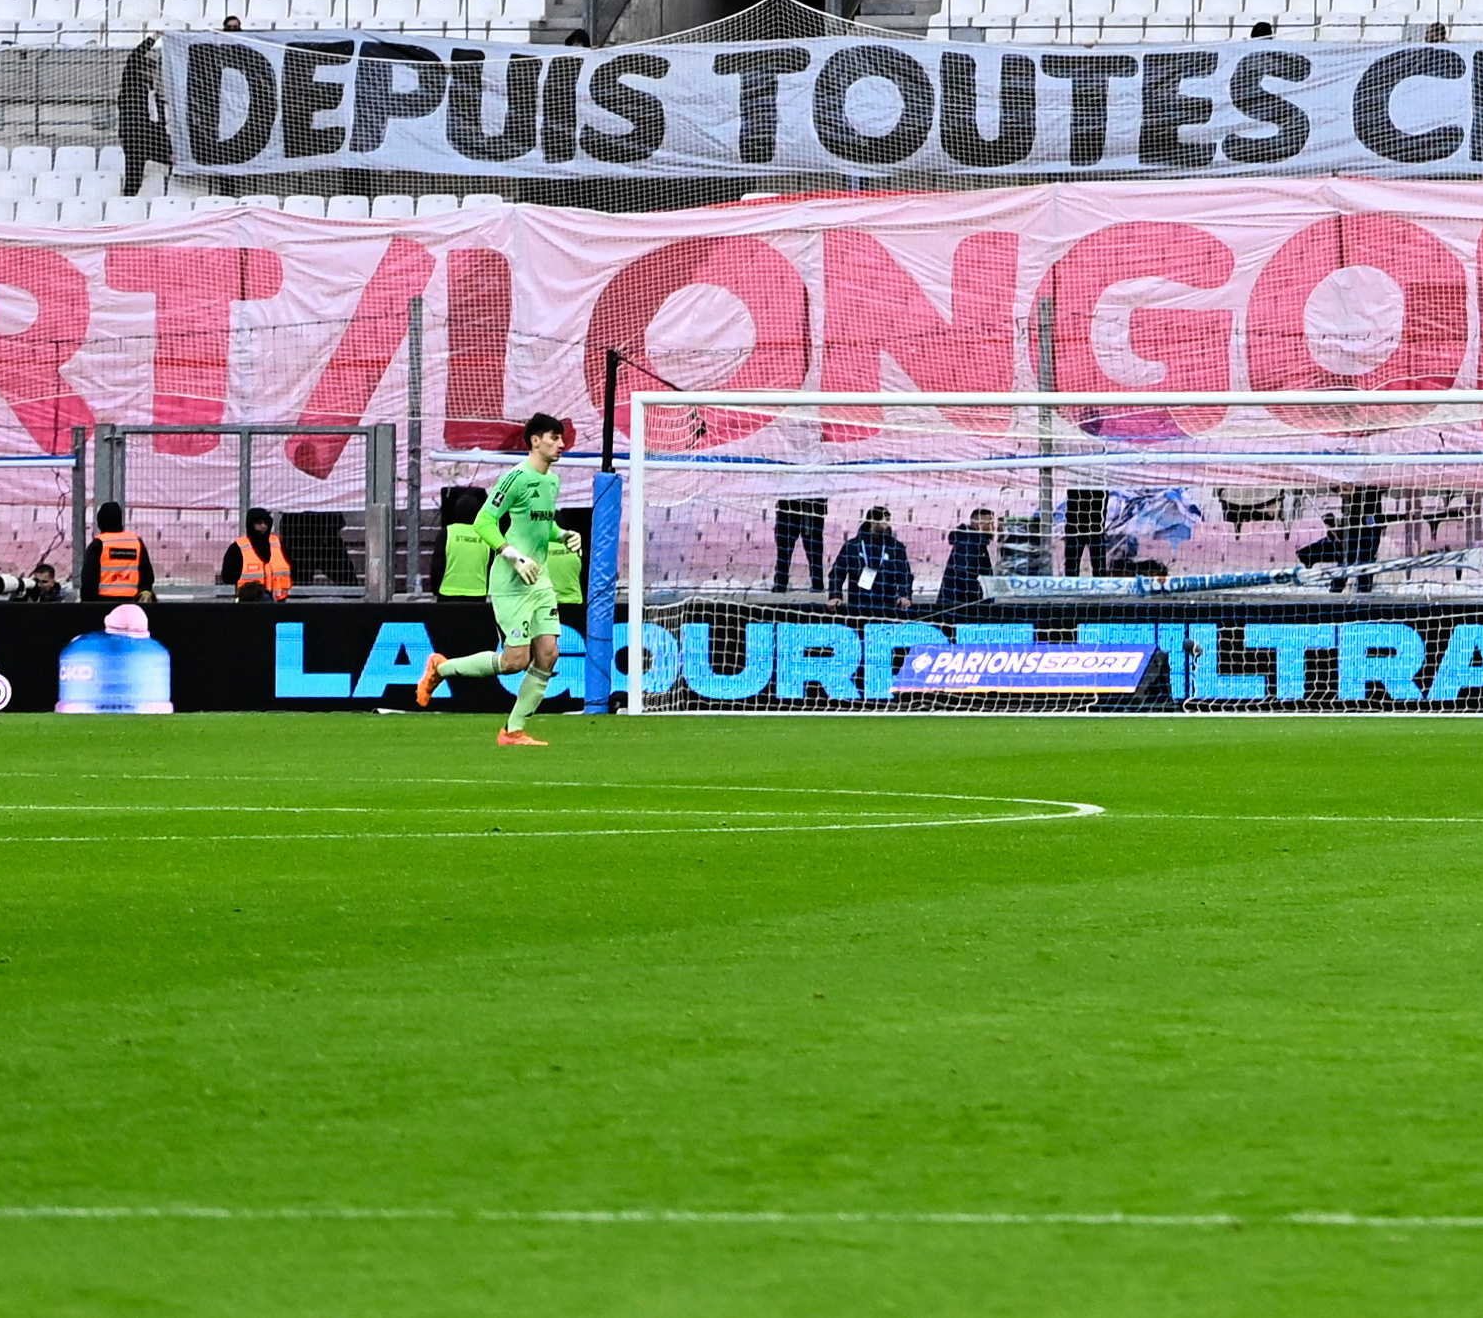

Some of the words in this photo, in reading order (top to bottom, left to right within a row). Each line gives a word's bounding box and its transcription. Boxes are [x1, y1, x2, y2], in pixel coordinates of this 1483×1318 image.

[188, 39, 669, 167] DEPUIS
[712, 44, 1312, 168] TOUTES
[275, 621, 452, 698] LA
[925, 674, 943, 683] EN
[945, 674, 981, 684] LIGNE
